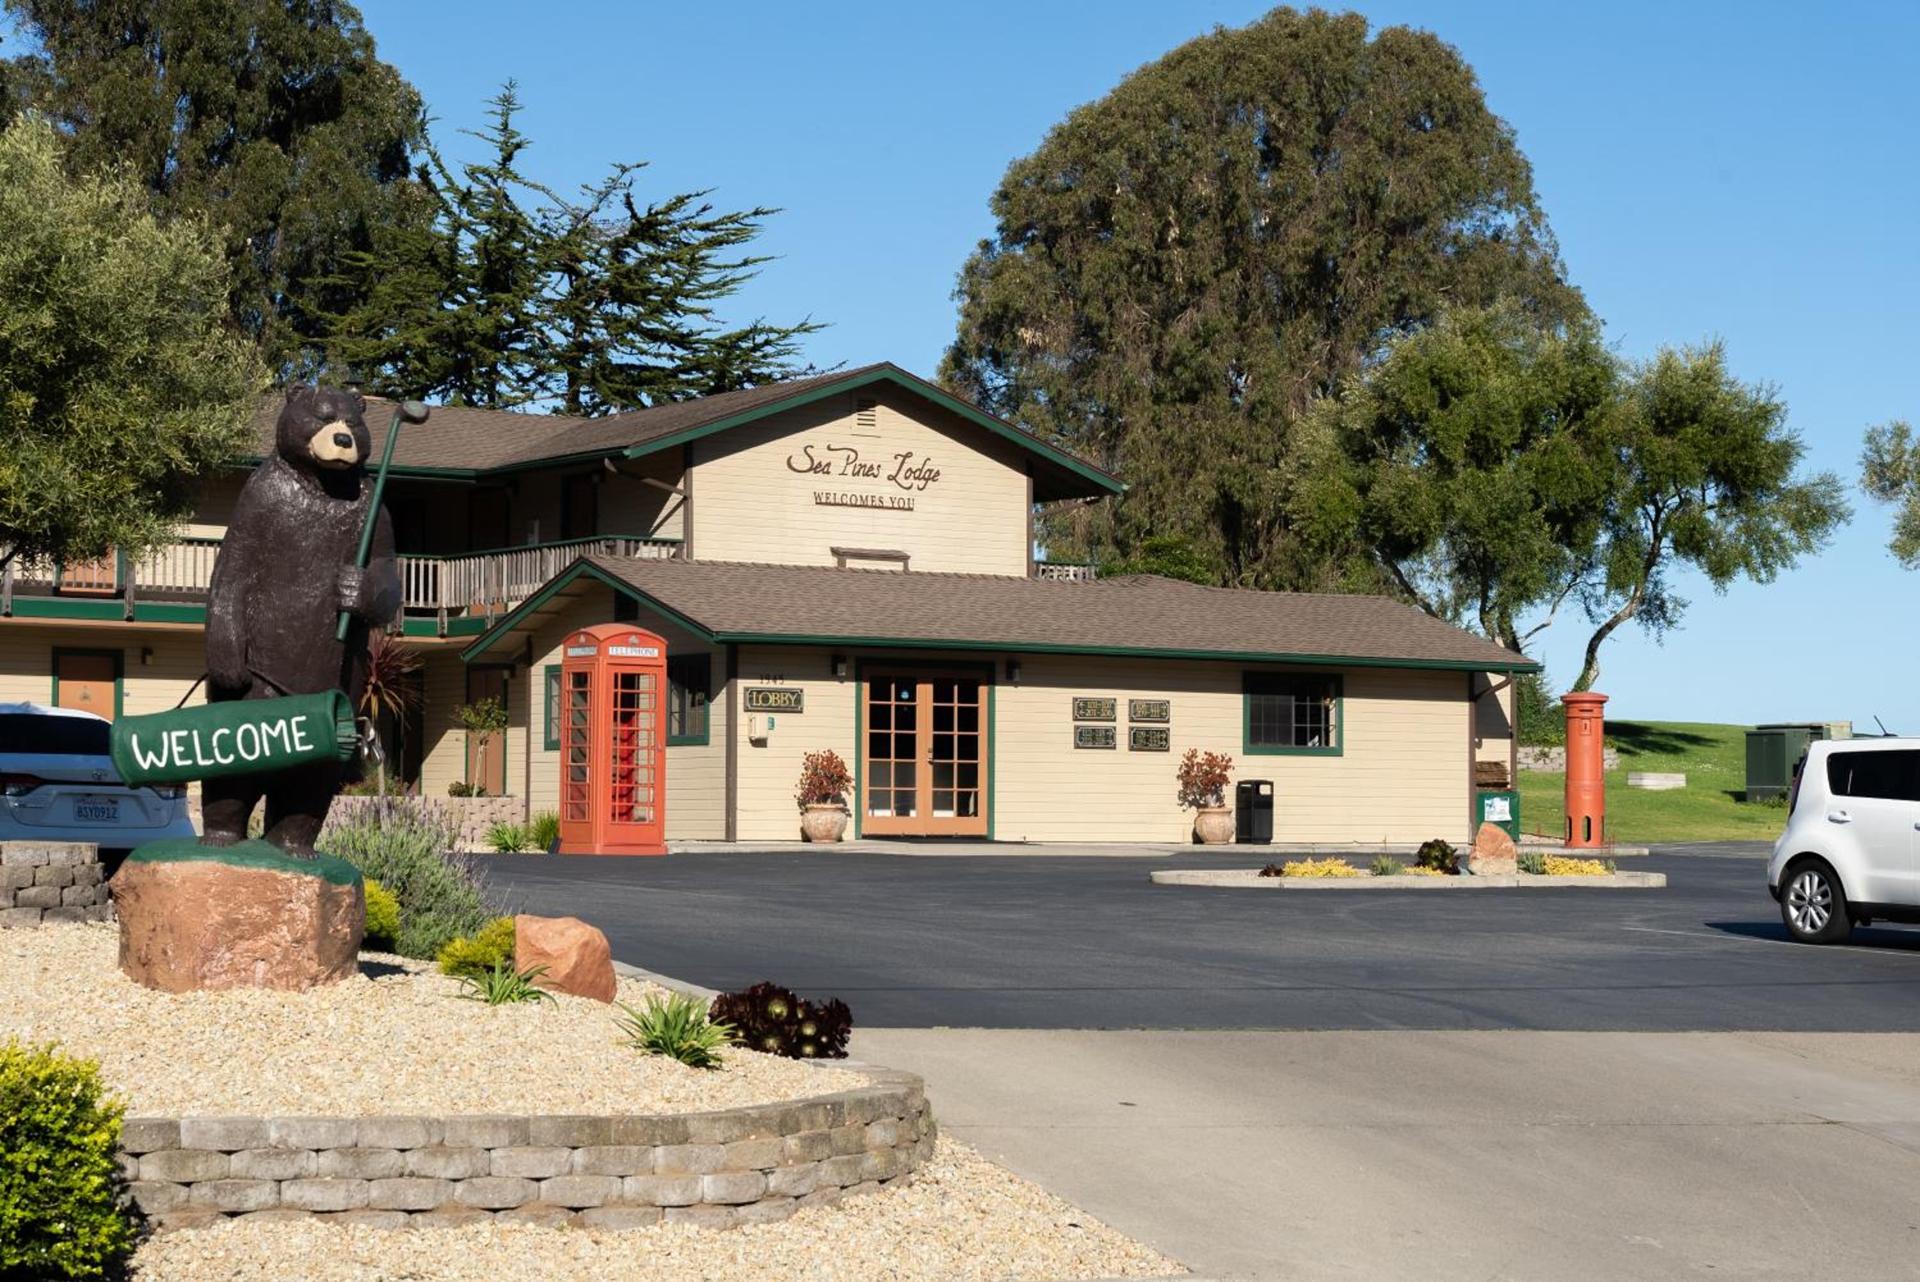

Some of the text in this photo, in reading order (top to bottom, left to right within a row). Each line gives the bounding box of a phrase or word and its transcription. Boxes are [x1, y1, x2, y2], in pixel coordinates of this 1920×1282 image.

[786, 443, 941, 491] Sea Pines Lodge
[813, 491, 915, 510] WELCOMES YOU
[610, 647, 656, 656] TELEPHONE
[752, 691, 798, 707] LOBBY
[131, 715, 314, 770] WELCOME
